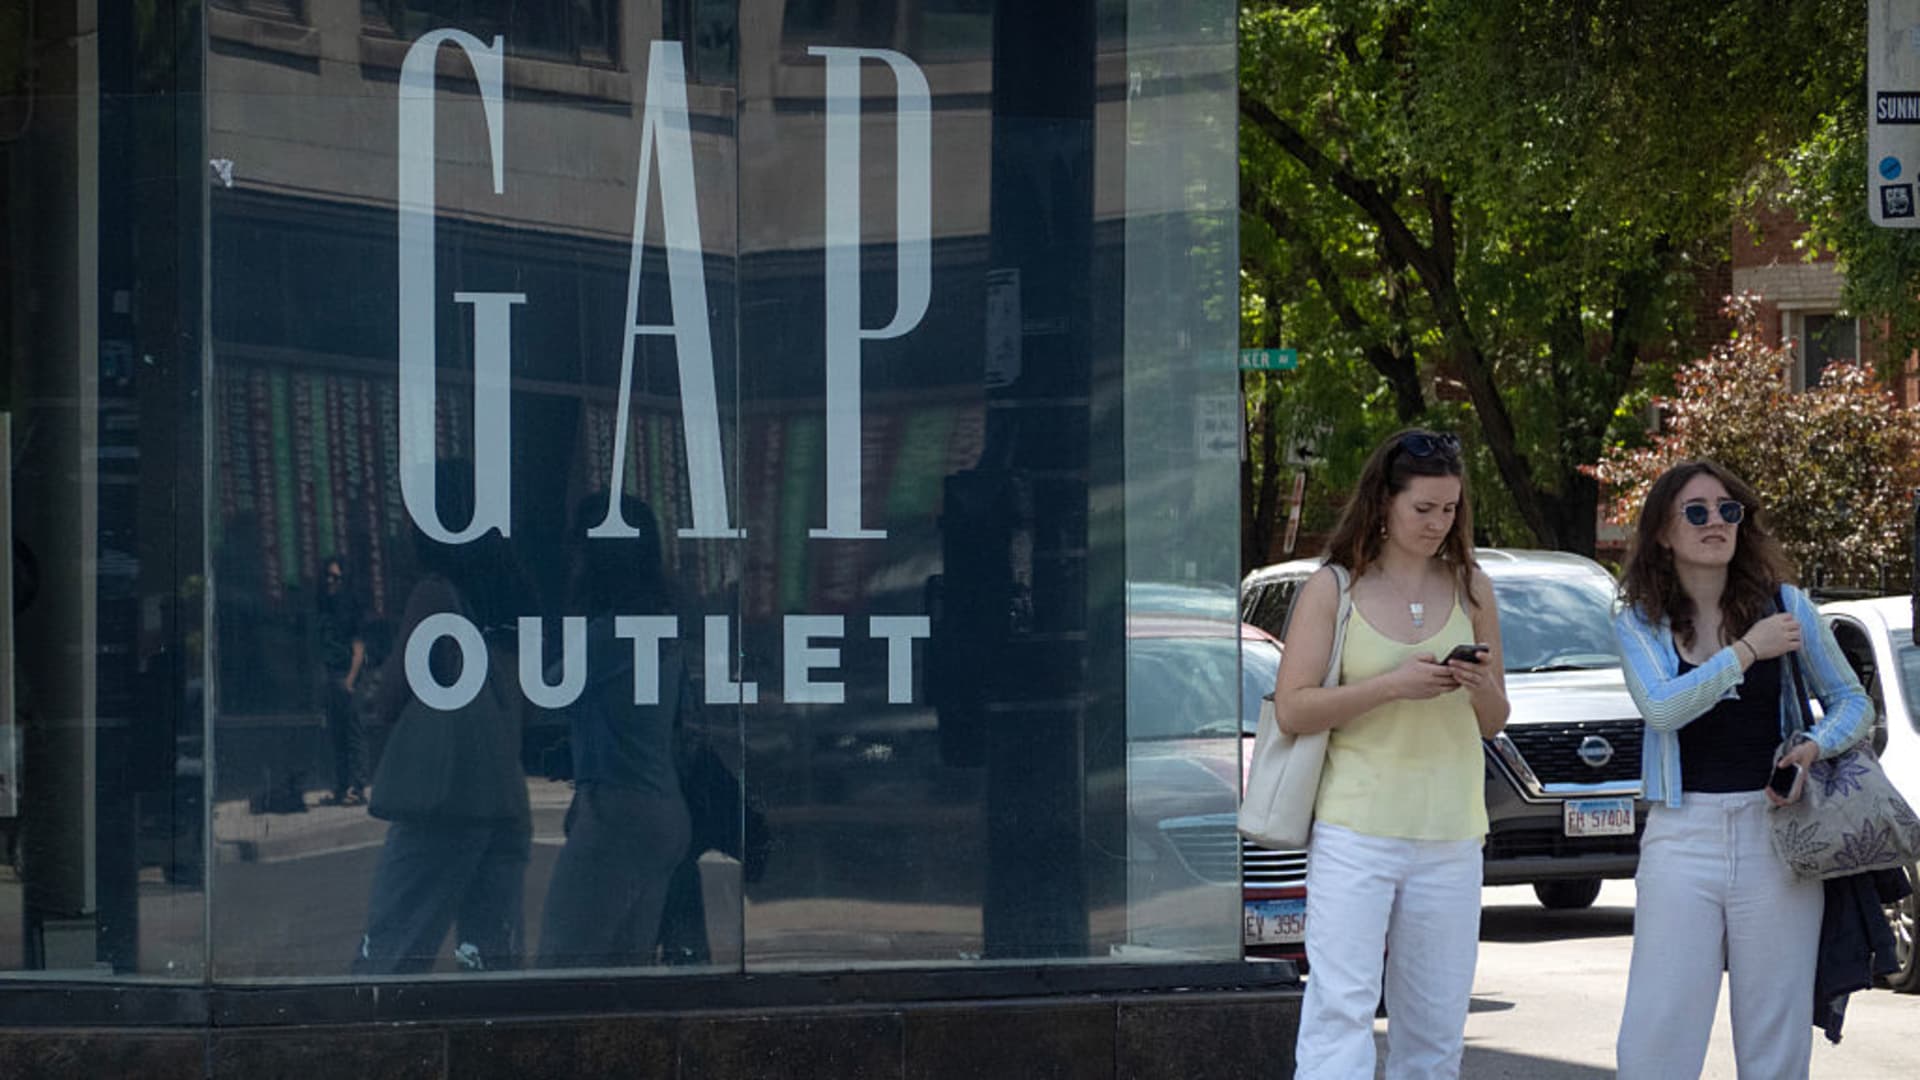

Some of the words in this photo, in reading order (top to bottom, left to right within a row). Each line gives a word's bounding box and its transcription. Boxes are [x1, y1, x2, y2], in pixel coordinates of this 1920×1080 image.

[1878, 96, 1920, 119] SUNN
[398, 28, 932, 543] GAP
[404, 612, 931, 710] OUTLET
